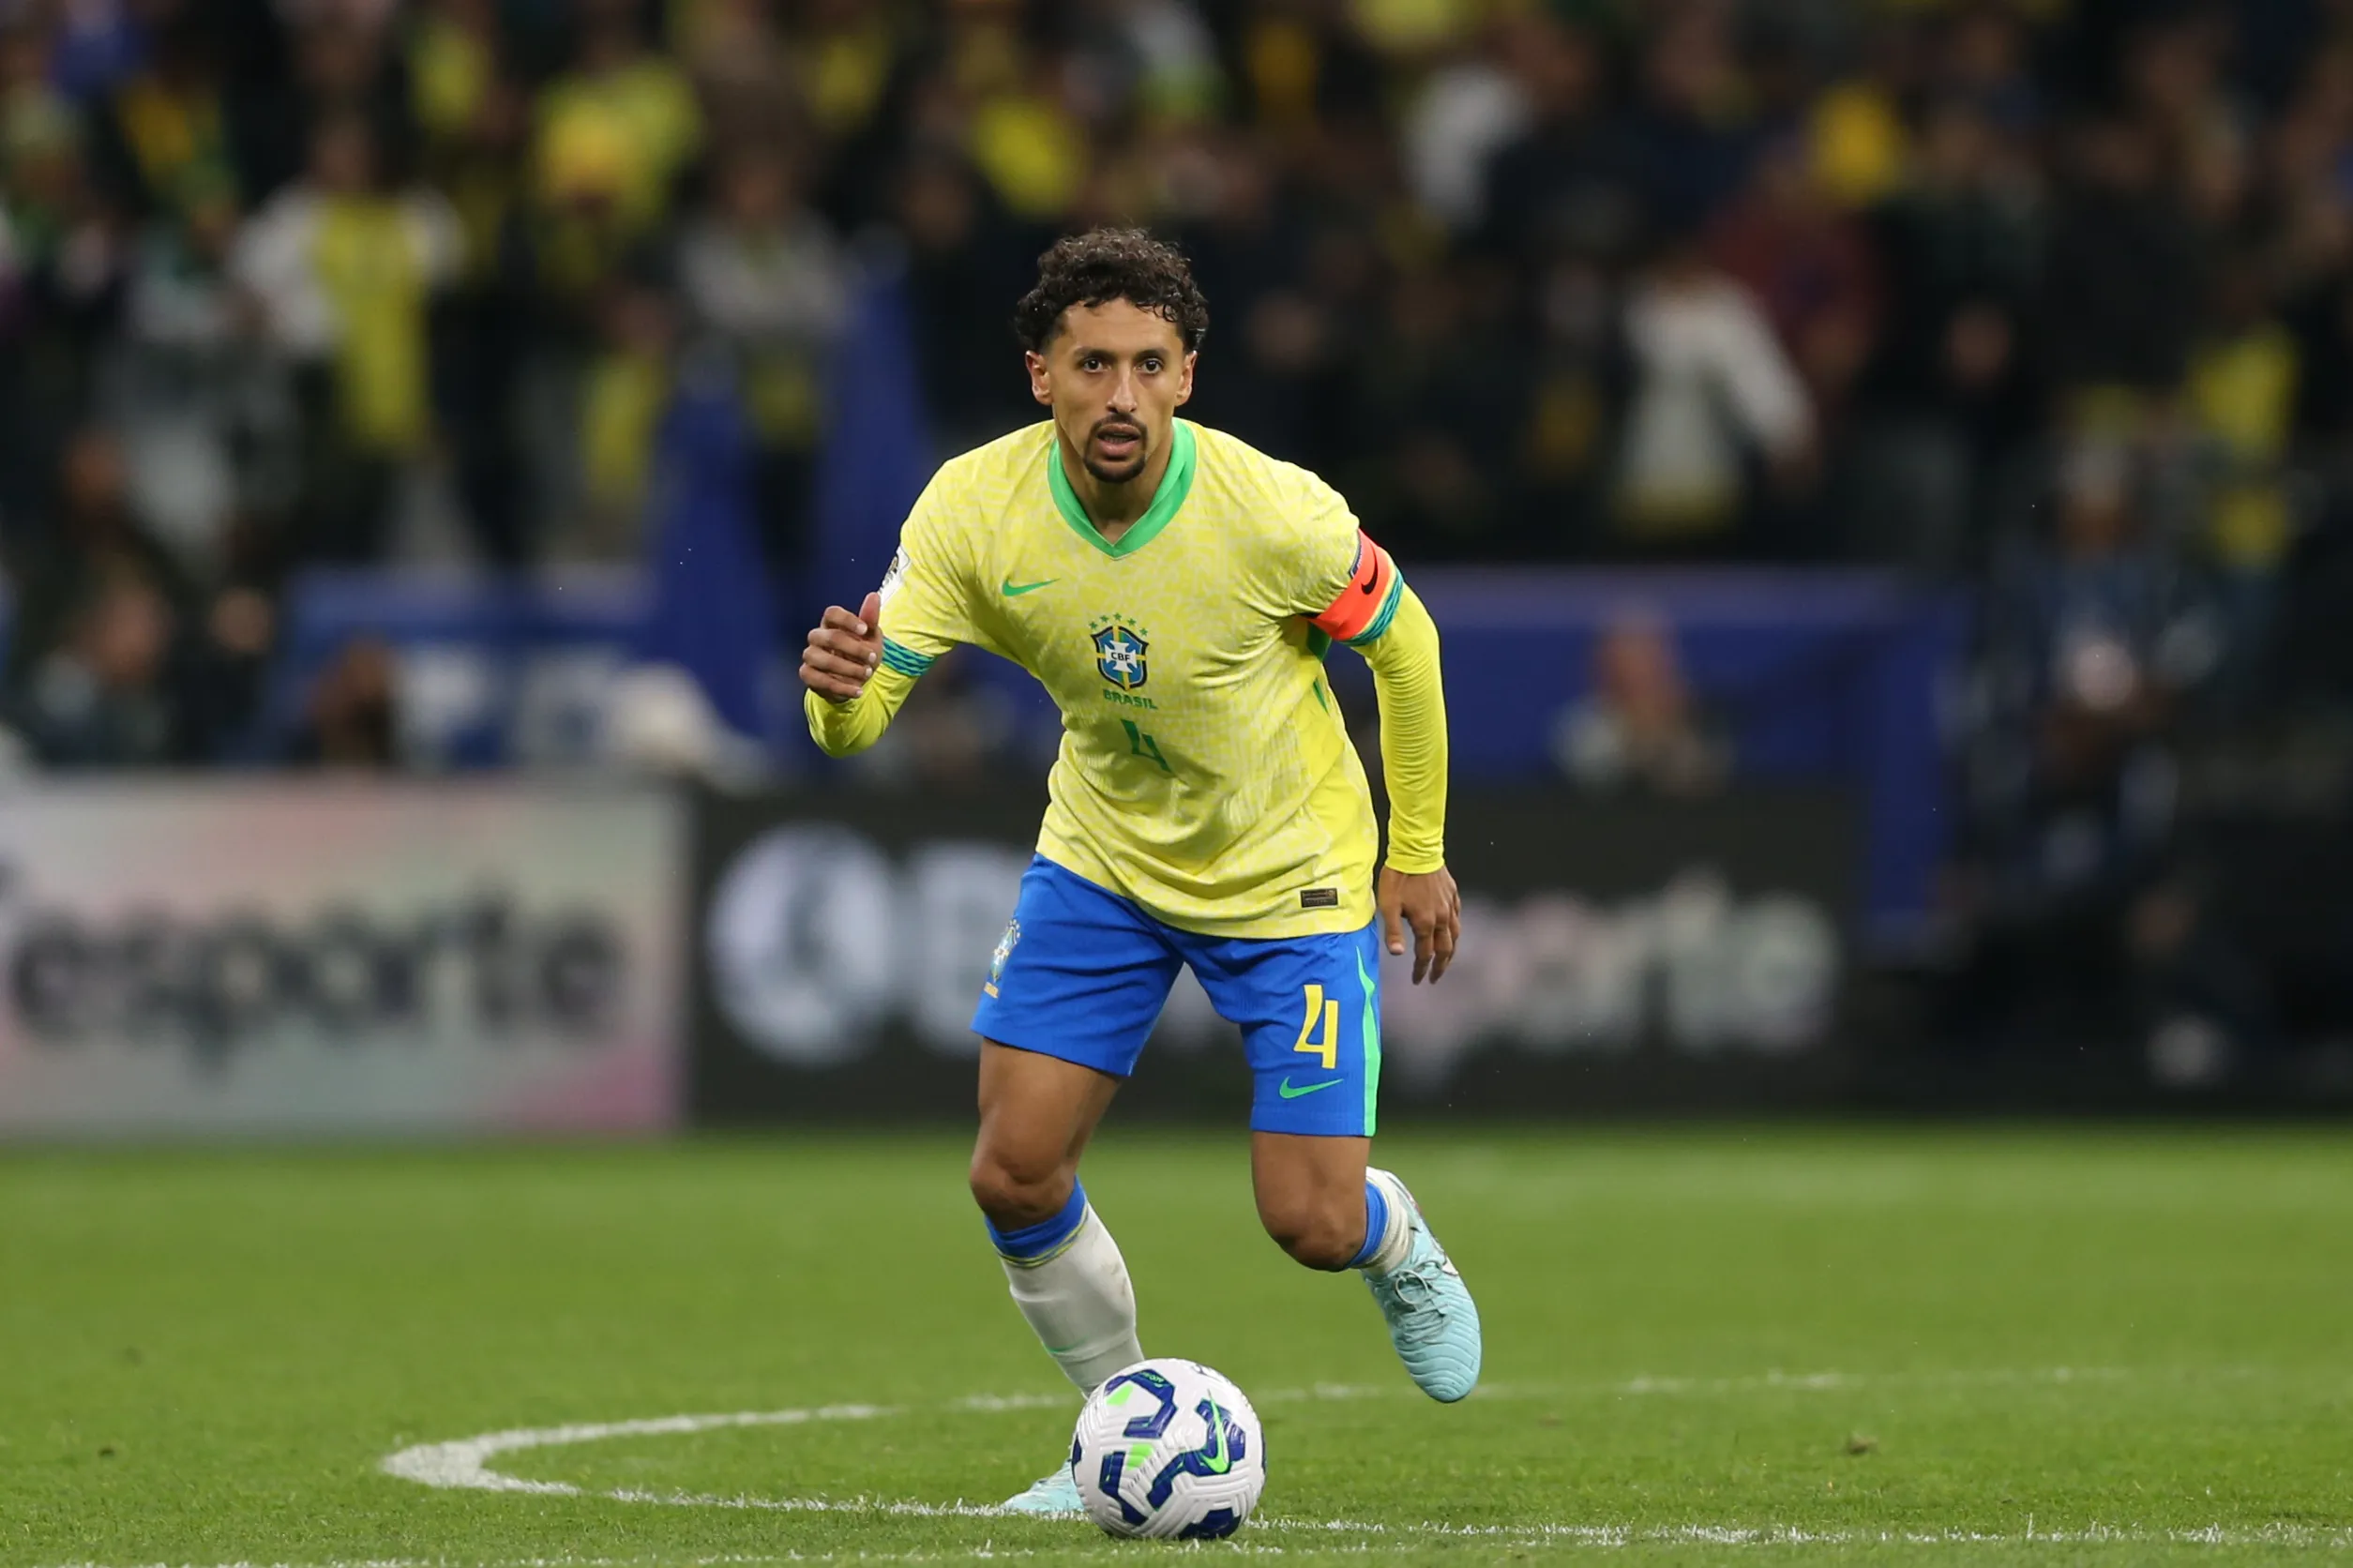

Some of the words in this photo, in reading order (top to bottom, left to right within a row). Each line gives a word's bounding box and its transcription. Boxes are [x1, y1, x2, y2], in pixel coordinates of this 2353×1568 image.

[1110, 652, 1131, 661] CBF
[1102, 688, 1158, 710] BRASIL
[1120, 718, 1175, 776] 4
[1292, 984, 1339, 1069] 4
